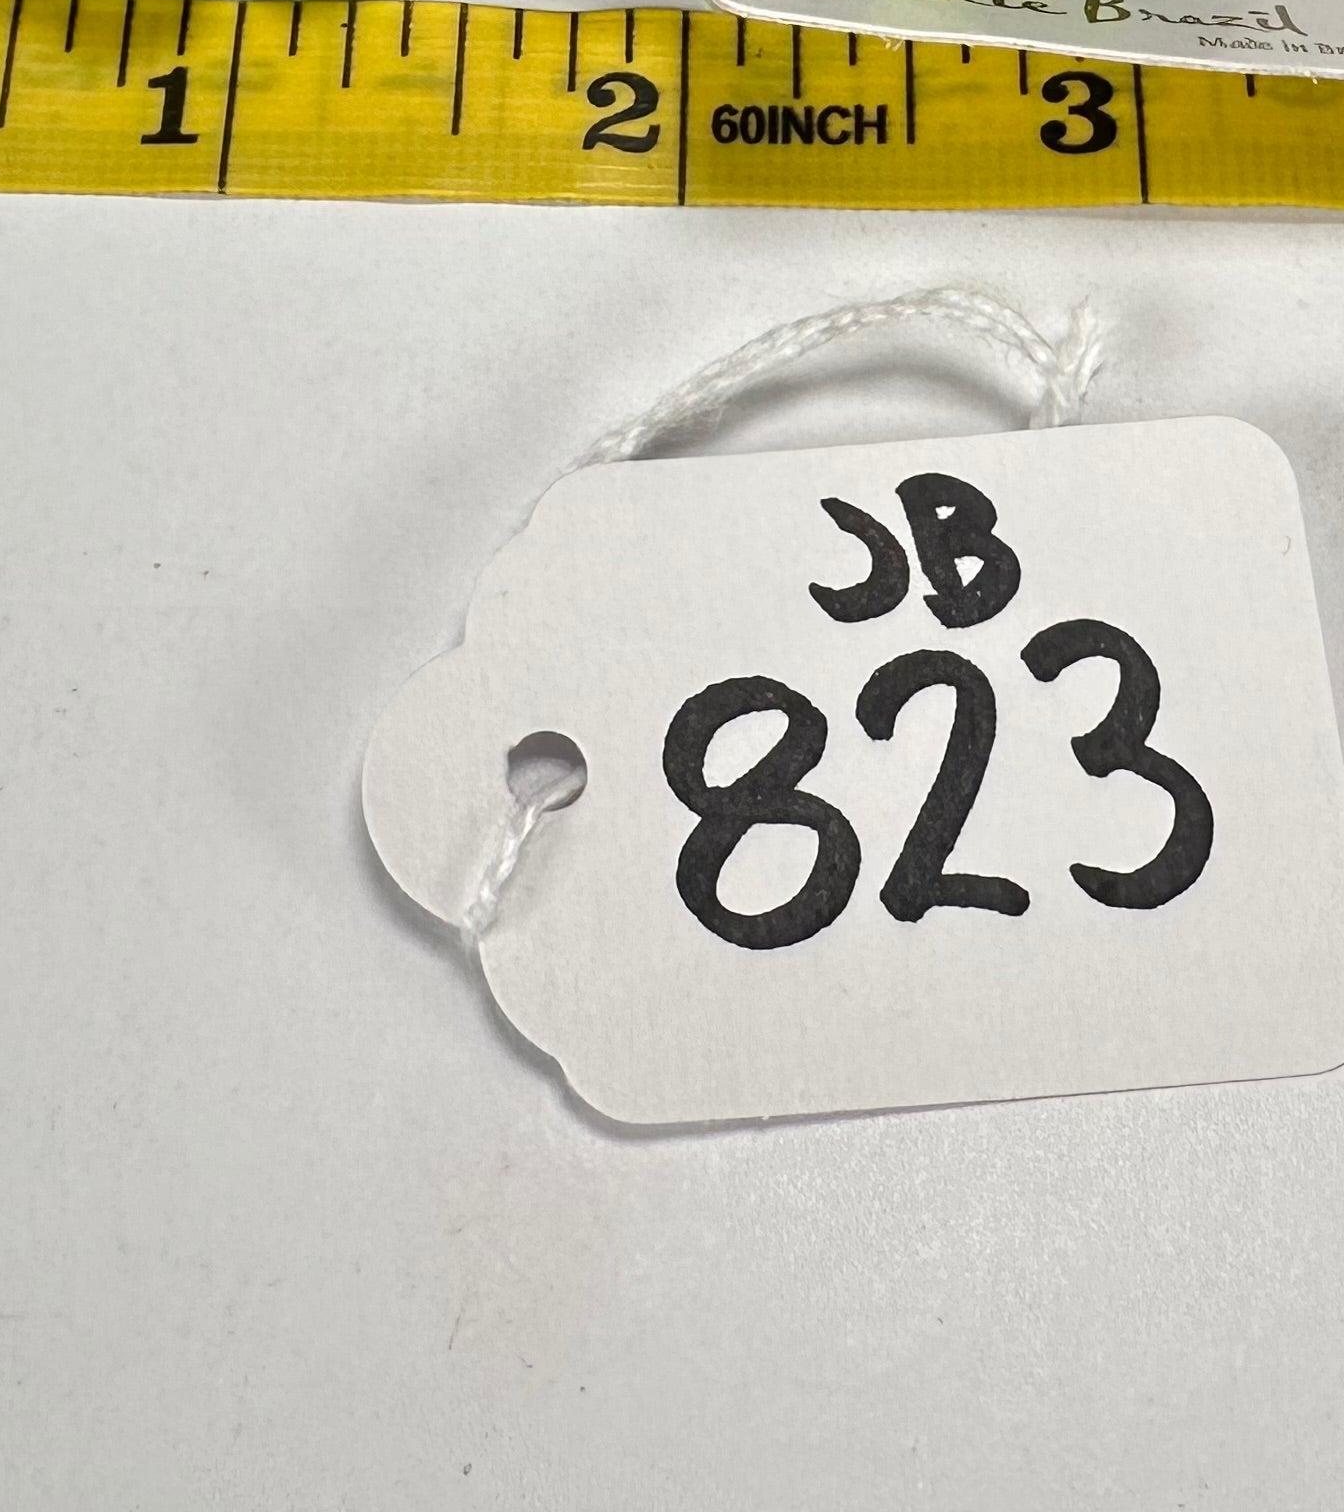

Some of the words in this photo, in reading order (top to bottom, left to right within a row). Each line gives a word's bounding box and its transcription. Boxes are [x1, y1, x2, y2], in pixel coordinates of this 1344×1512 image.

[1197, 36, 1274, 51] Made
[140, 66, 199, 145] 1
[582, 71, 661, 154] 2
[710, 103, 888, 146] 60INCH
[1039, 70, 1119, 155] 3
[662, 618, 1215, 951] 823
